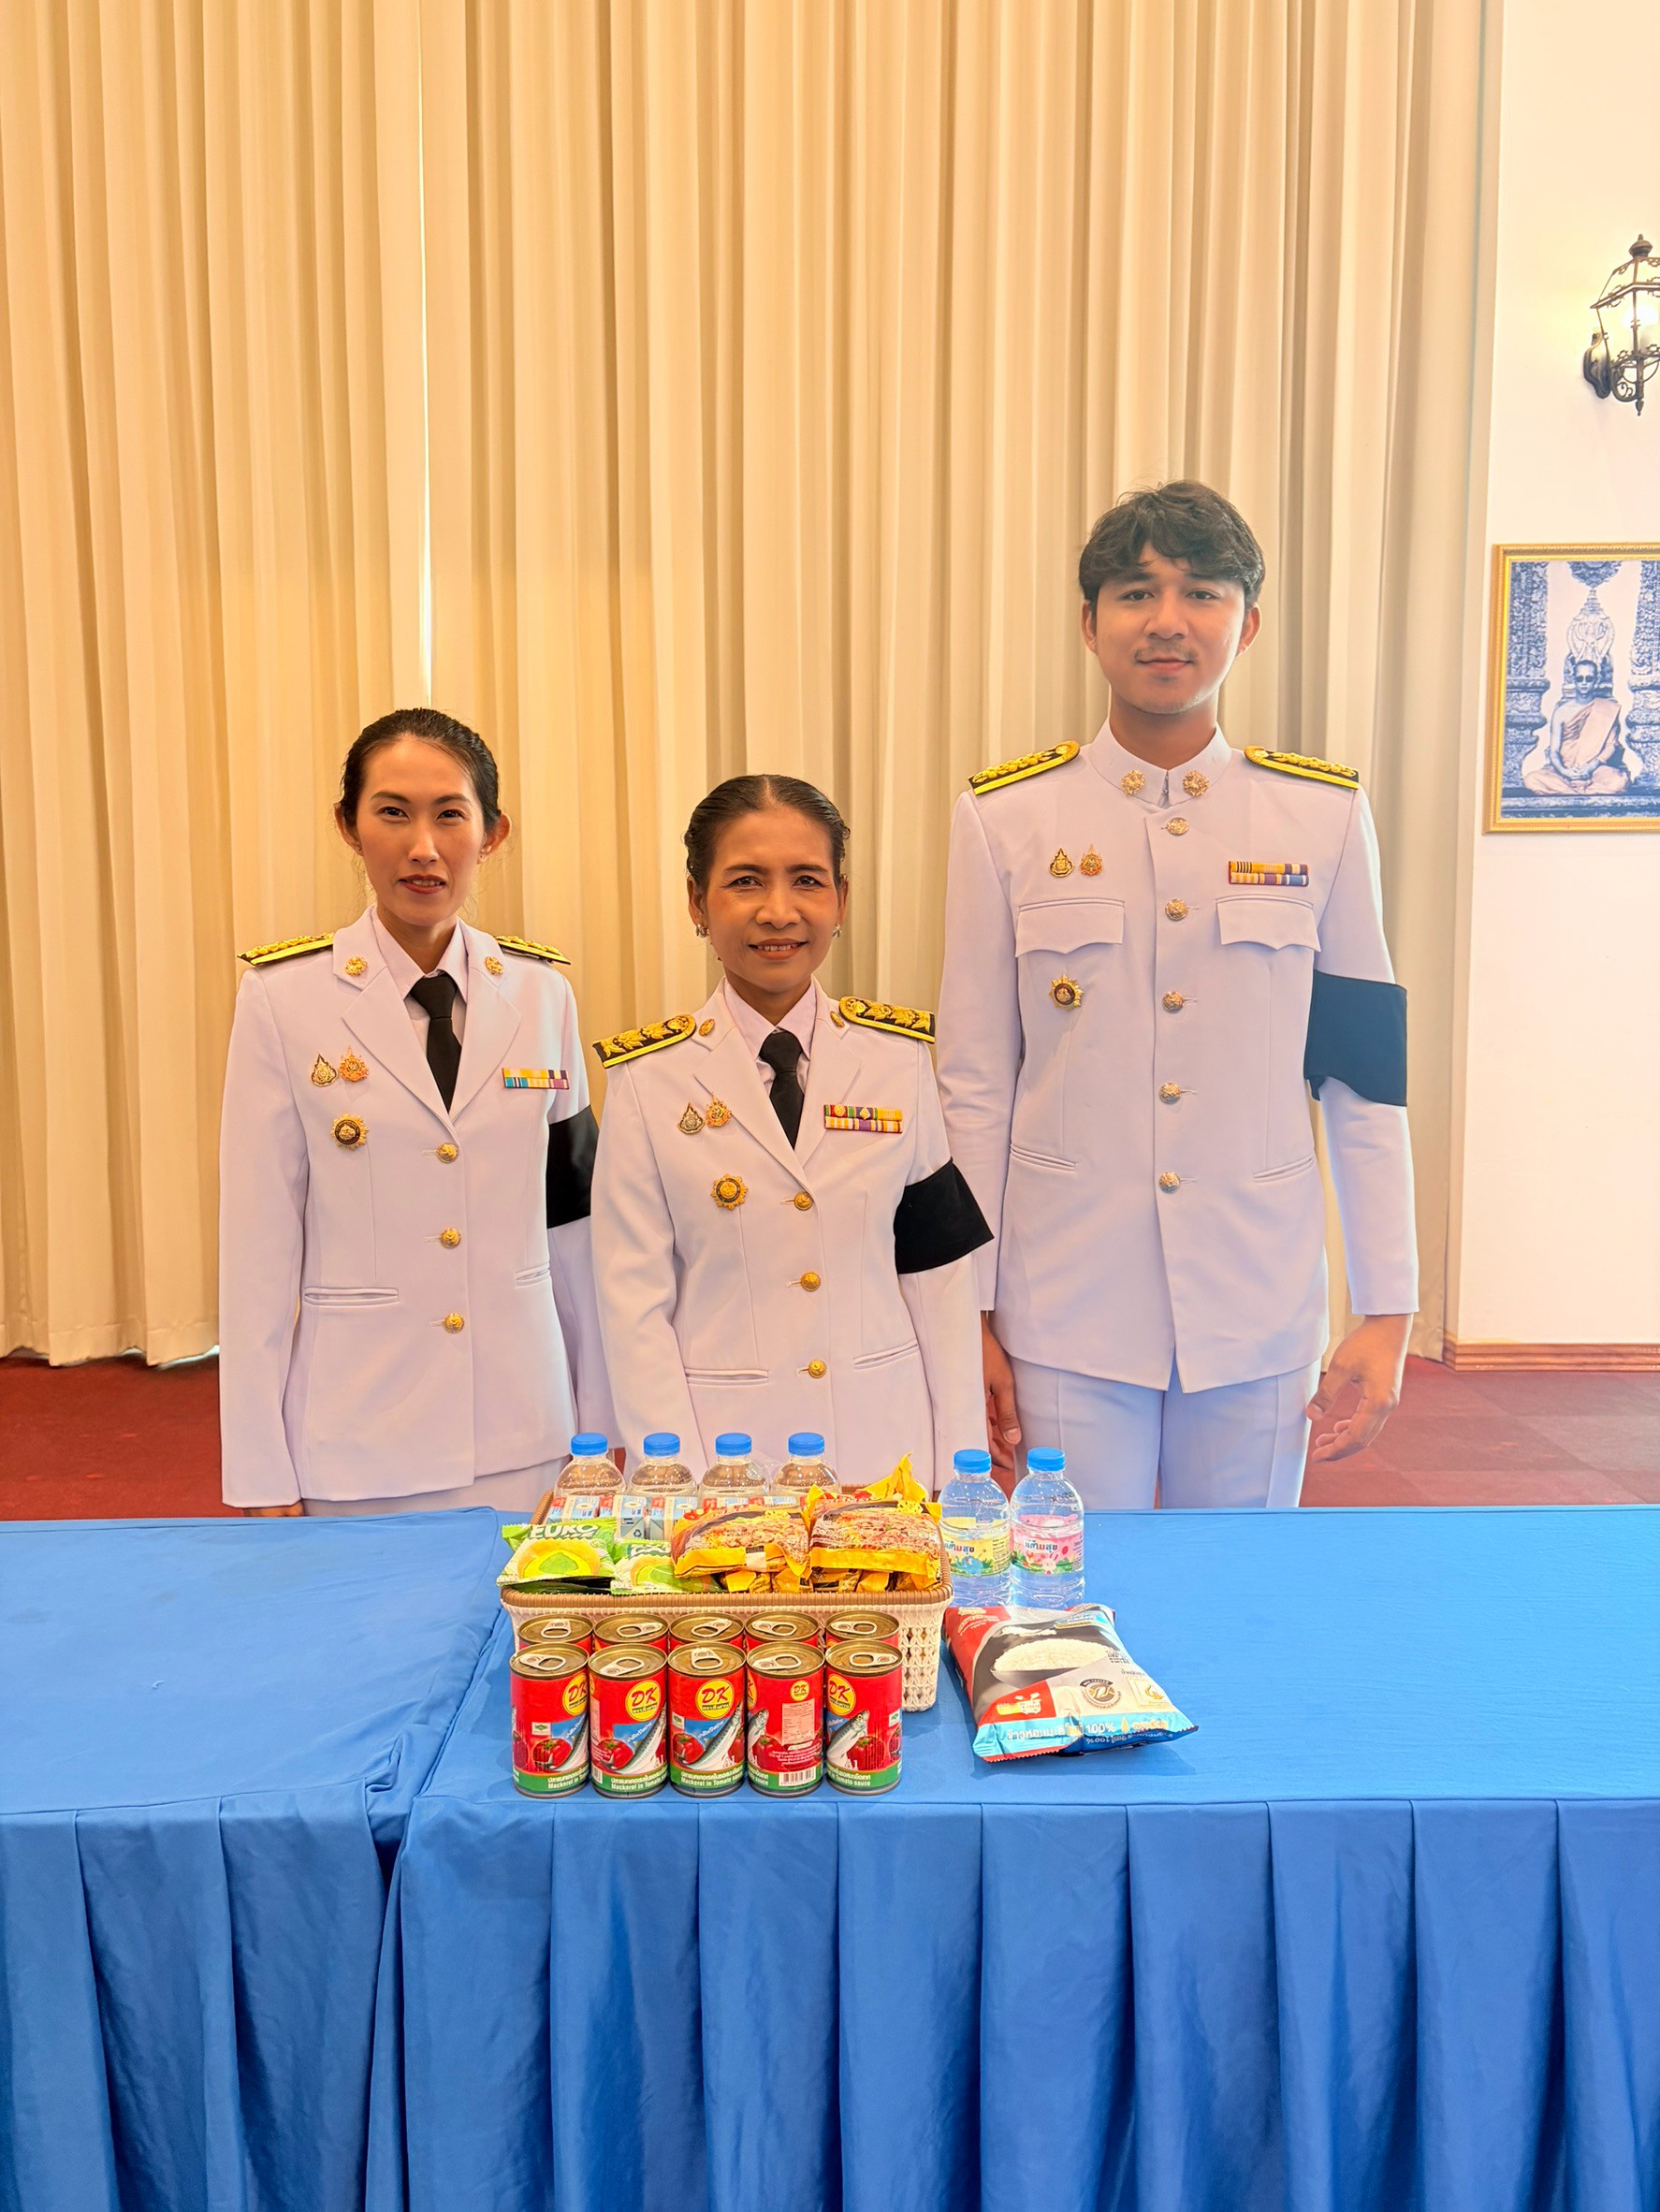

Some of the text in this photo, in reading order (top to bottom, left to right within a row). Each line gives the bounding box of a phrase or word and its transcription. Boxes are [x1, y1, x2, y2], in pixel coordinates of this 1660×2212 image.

[632, 1686, 658, 1707] DK
[701, 1686, 729, 1704] DK
[794, 1684, 808, 1695] DK
[829, 1681, 849, 1702] DK
[1085, 1722, 1115, 1734] 100%
